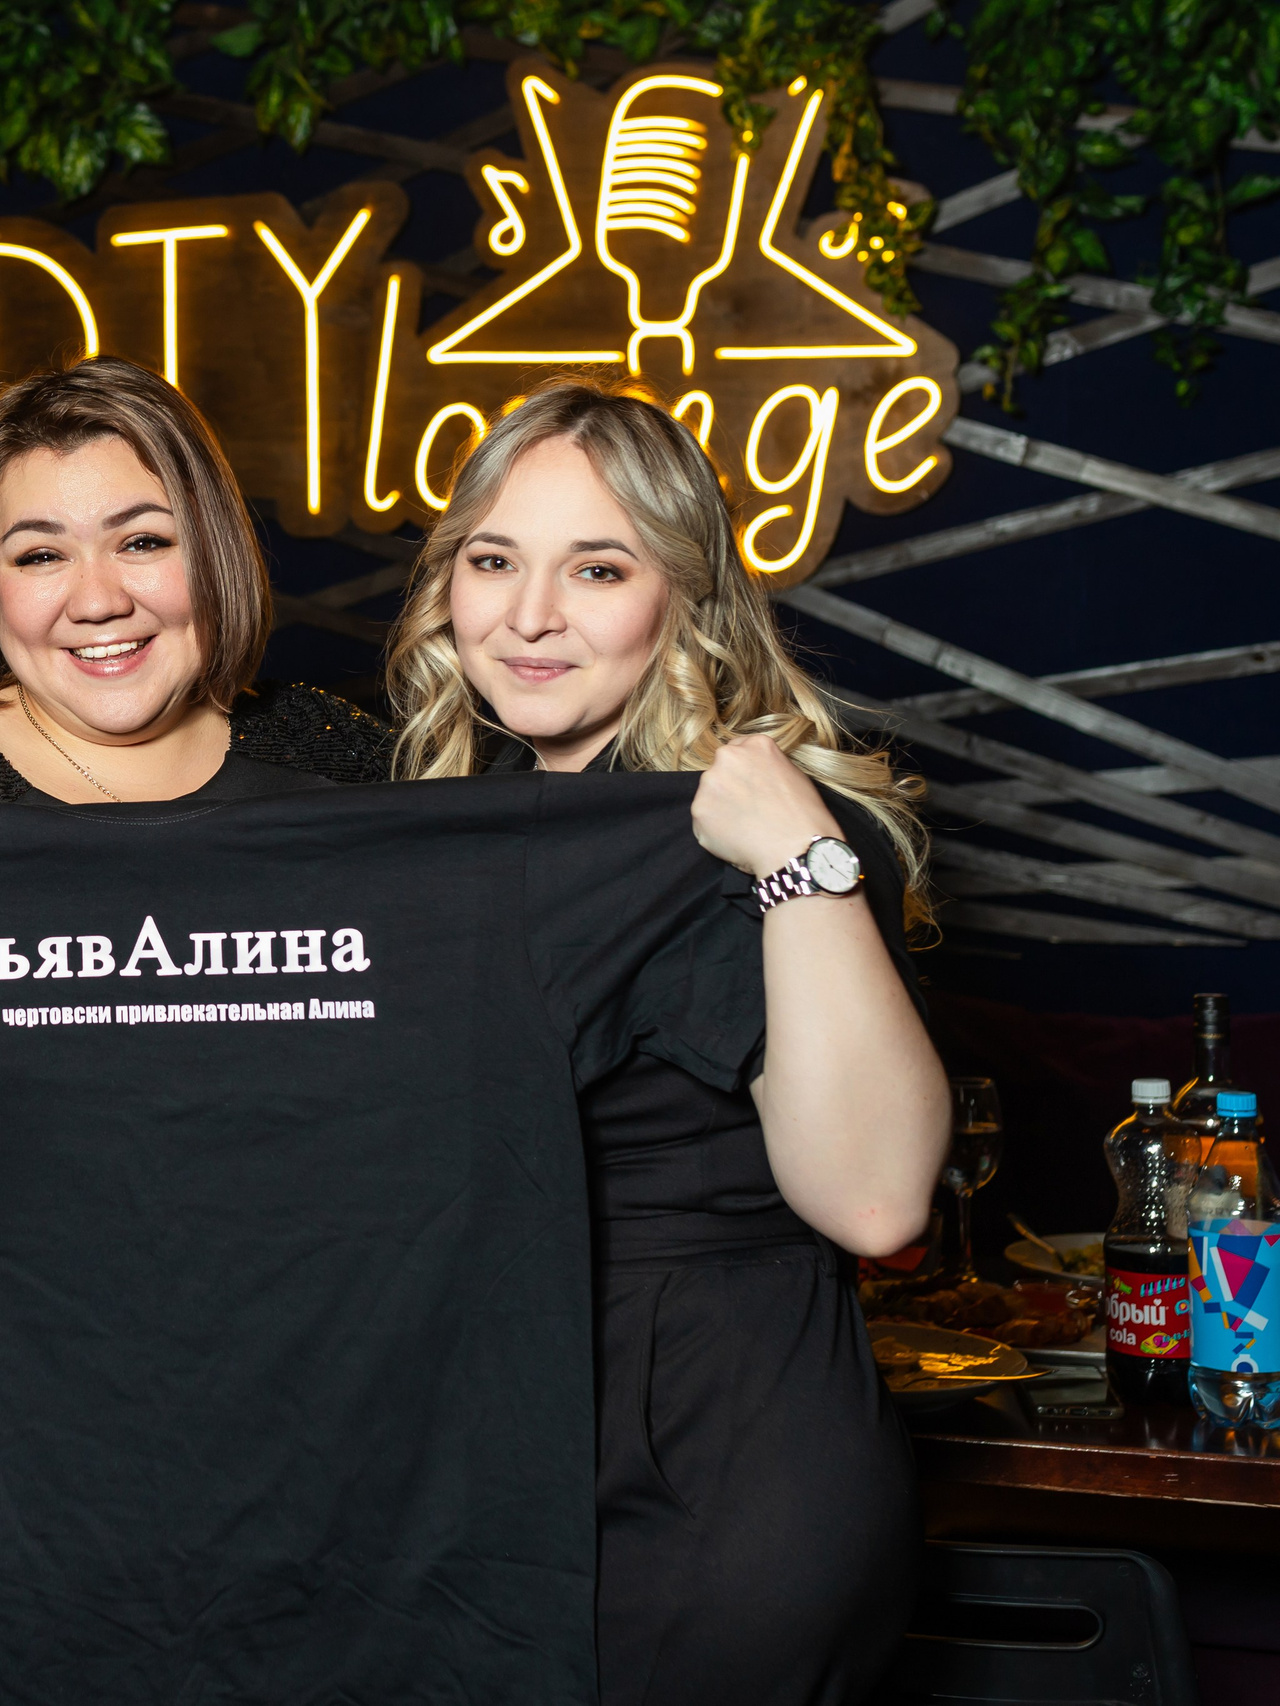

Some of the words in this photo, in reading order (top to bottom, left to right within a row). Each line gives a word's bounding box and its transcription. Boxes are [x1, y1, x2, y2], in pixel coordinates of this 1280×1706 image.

[364, 274, 943, 573] loge
[2, 1005, 112, 1028] чертовски
[115, 1000, 305, 1025] привлекательная
[308, 998, 376, 1020] Алина
[1109, 1327, 1137, 1346] cola
